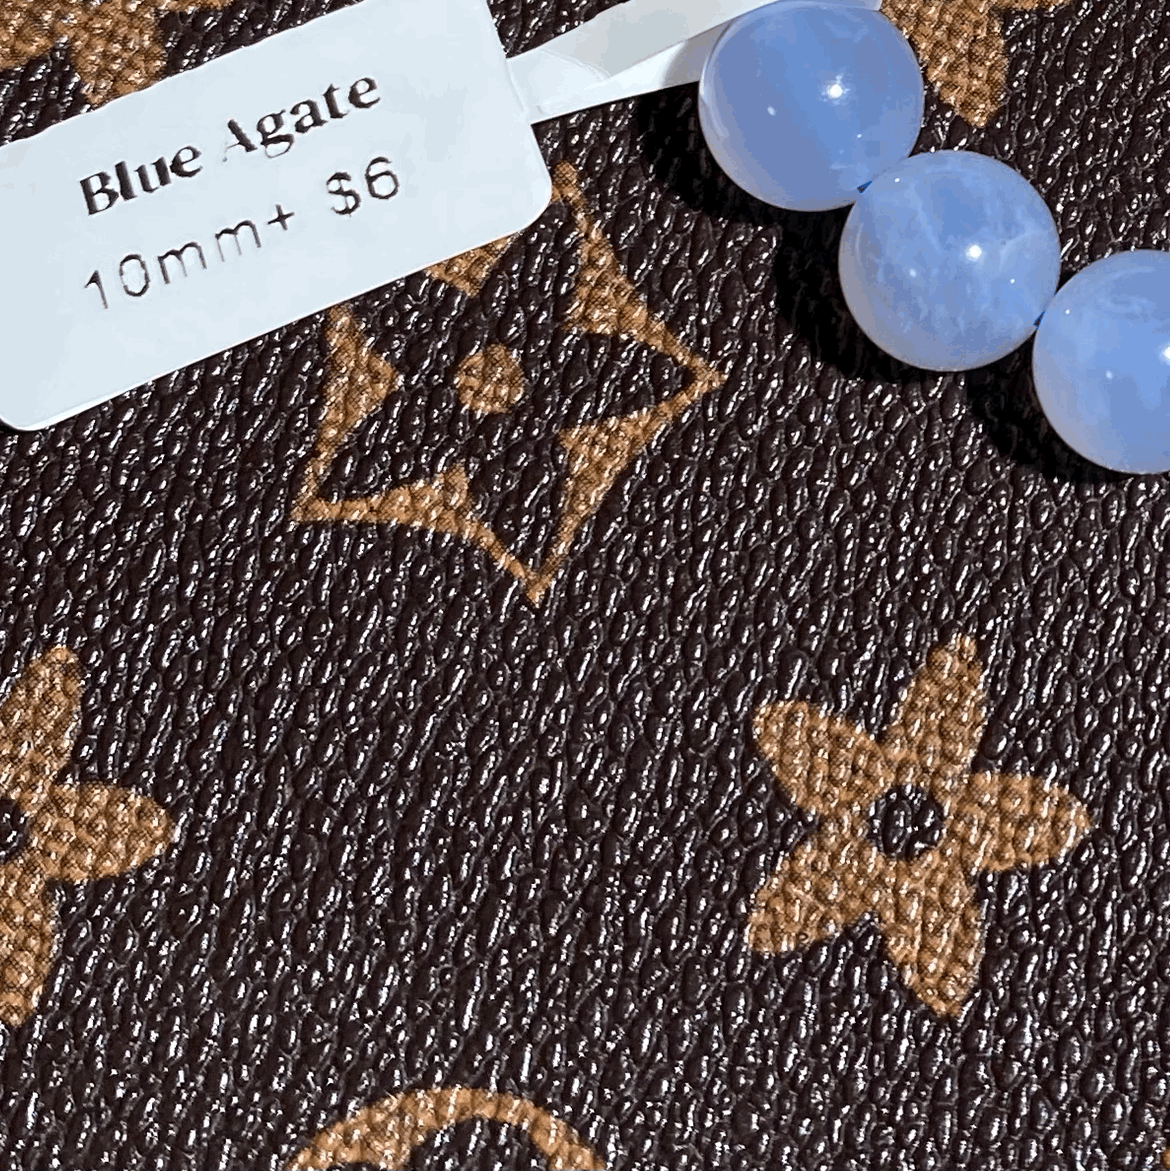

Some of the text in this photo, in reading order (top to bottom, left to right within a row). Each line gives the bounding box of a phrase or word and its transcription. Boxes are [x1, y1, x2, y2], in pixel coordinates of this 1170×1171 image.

[78, 75, 382, 217] Blue Agate
[83, 156, 400, 310] 10mm+ $6
